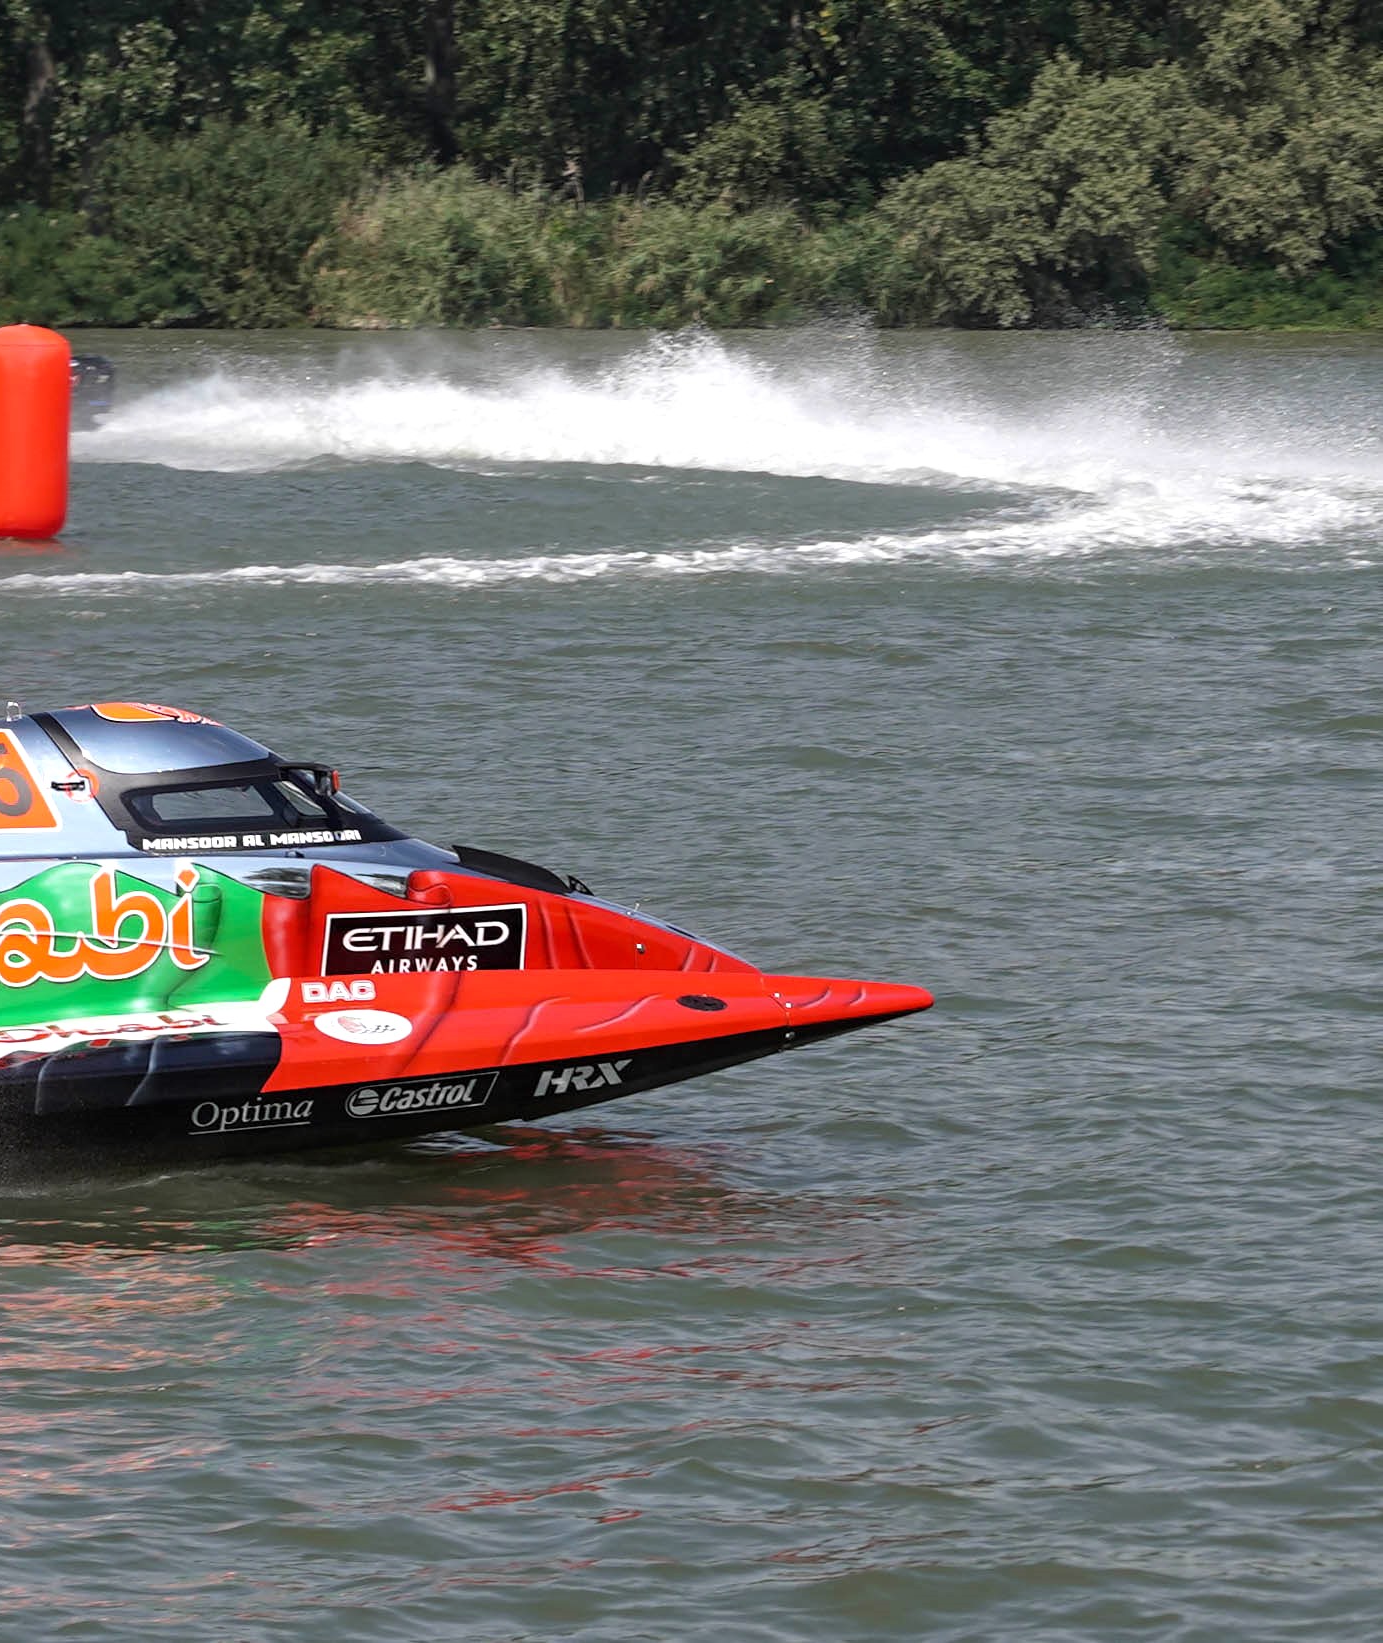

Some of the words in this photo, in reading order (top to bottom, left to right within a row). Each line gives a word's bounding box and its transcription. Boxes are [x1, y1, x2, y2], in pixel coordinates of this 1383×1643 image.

[142, 835, 237, 850] MANSOOR
[242, 833, 265, 847] AL
[269, 829, 362, 846] MANSOORI
[342, 921, 510, 952] ETIHAD
[371, 955, 478, 975] AIRWAYS
[533, 1059, 633, 1097] HRX
[379, 1079, 473, 1112] Castrol
[191, 1096, 315, 1131] Optima
